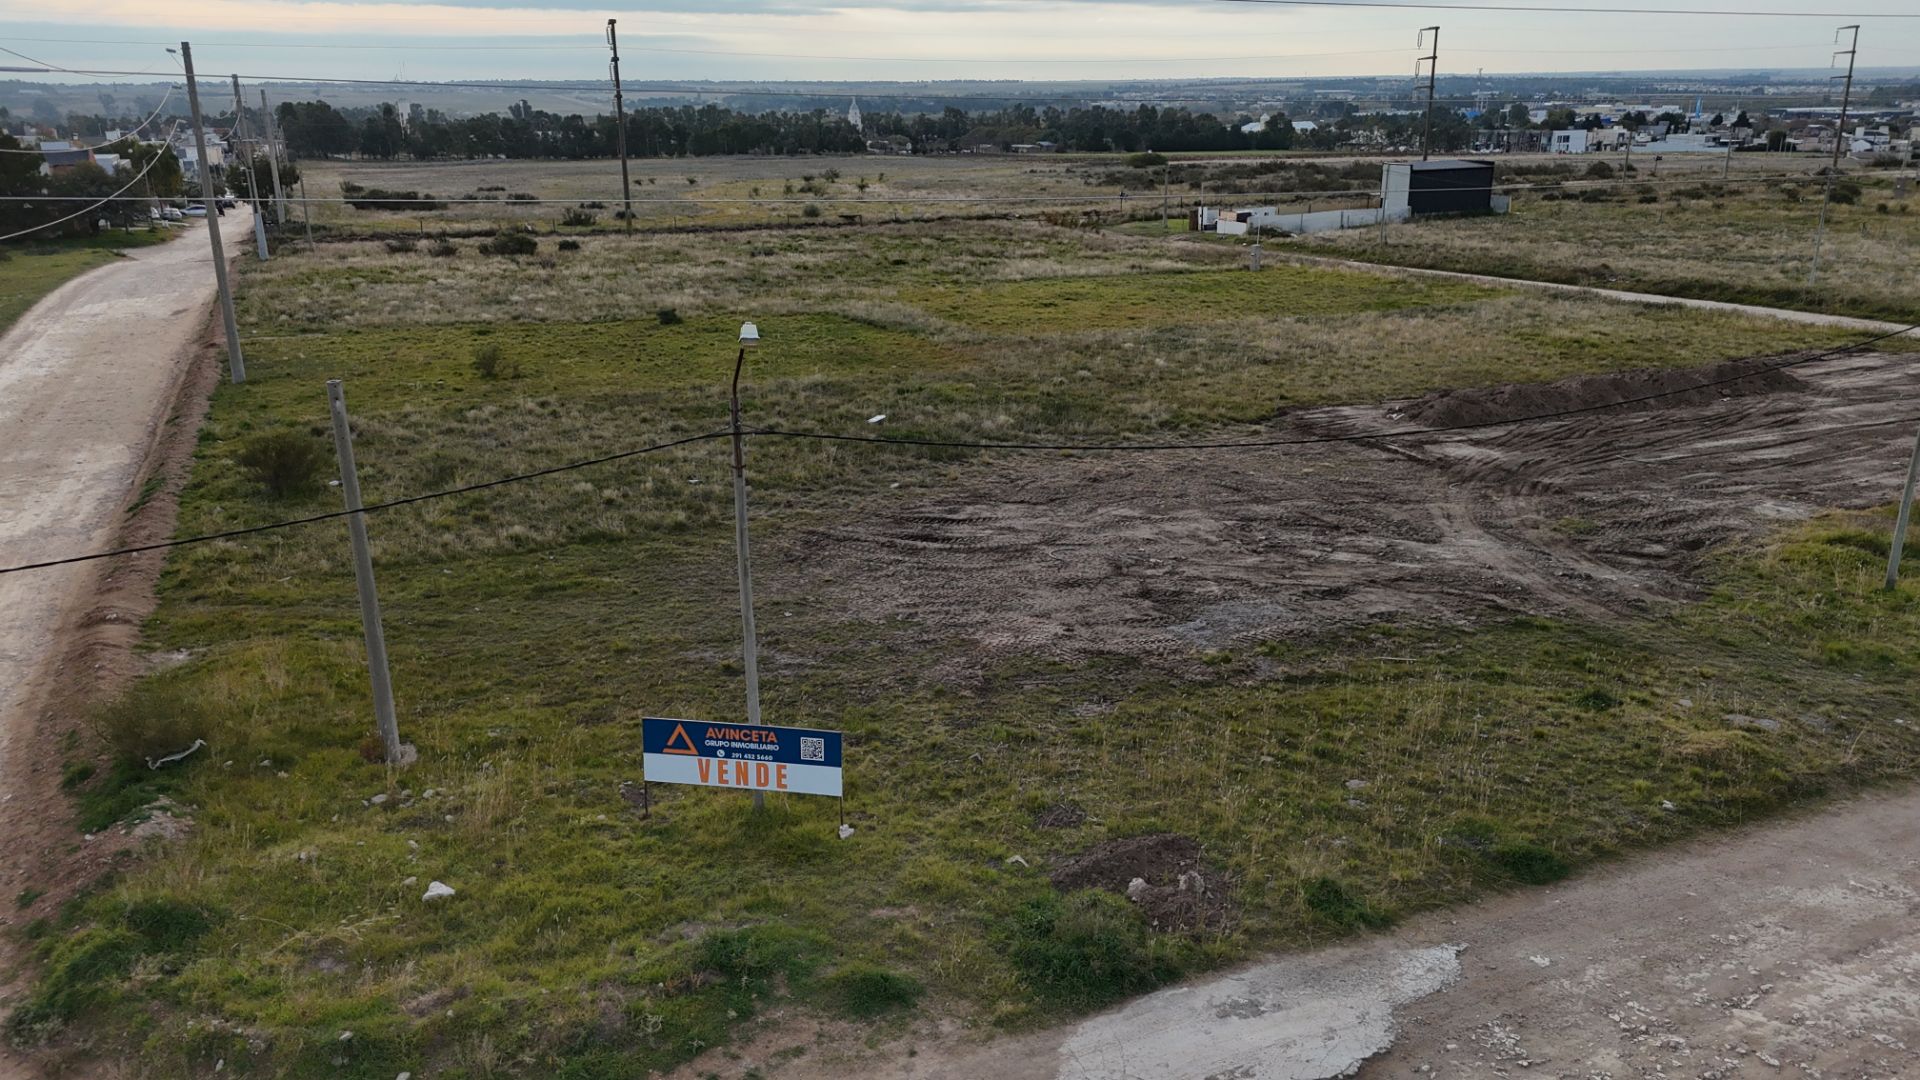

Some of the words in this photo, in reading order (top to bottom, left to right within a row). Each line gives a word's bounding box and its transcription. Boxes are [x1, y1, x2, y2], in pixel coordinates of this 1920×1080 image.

[705, 727, 778, 743] AVINCETA
[704, 739, 730, 748] GRUPO
[731, 741, 780, 751] INMOBILIARIO
[697, 758, 788, 788] VENDE
